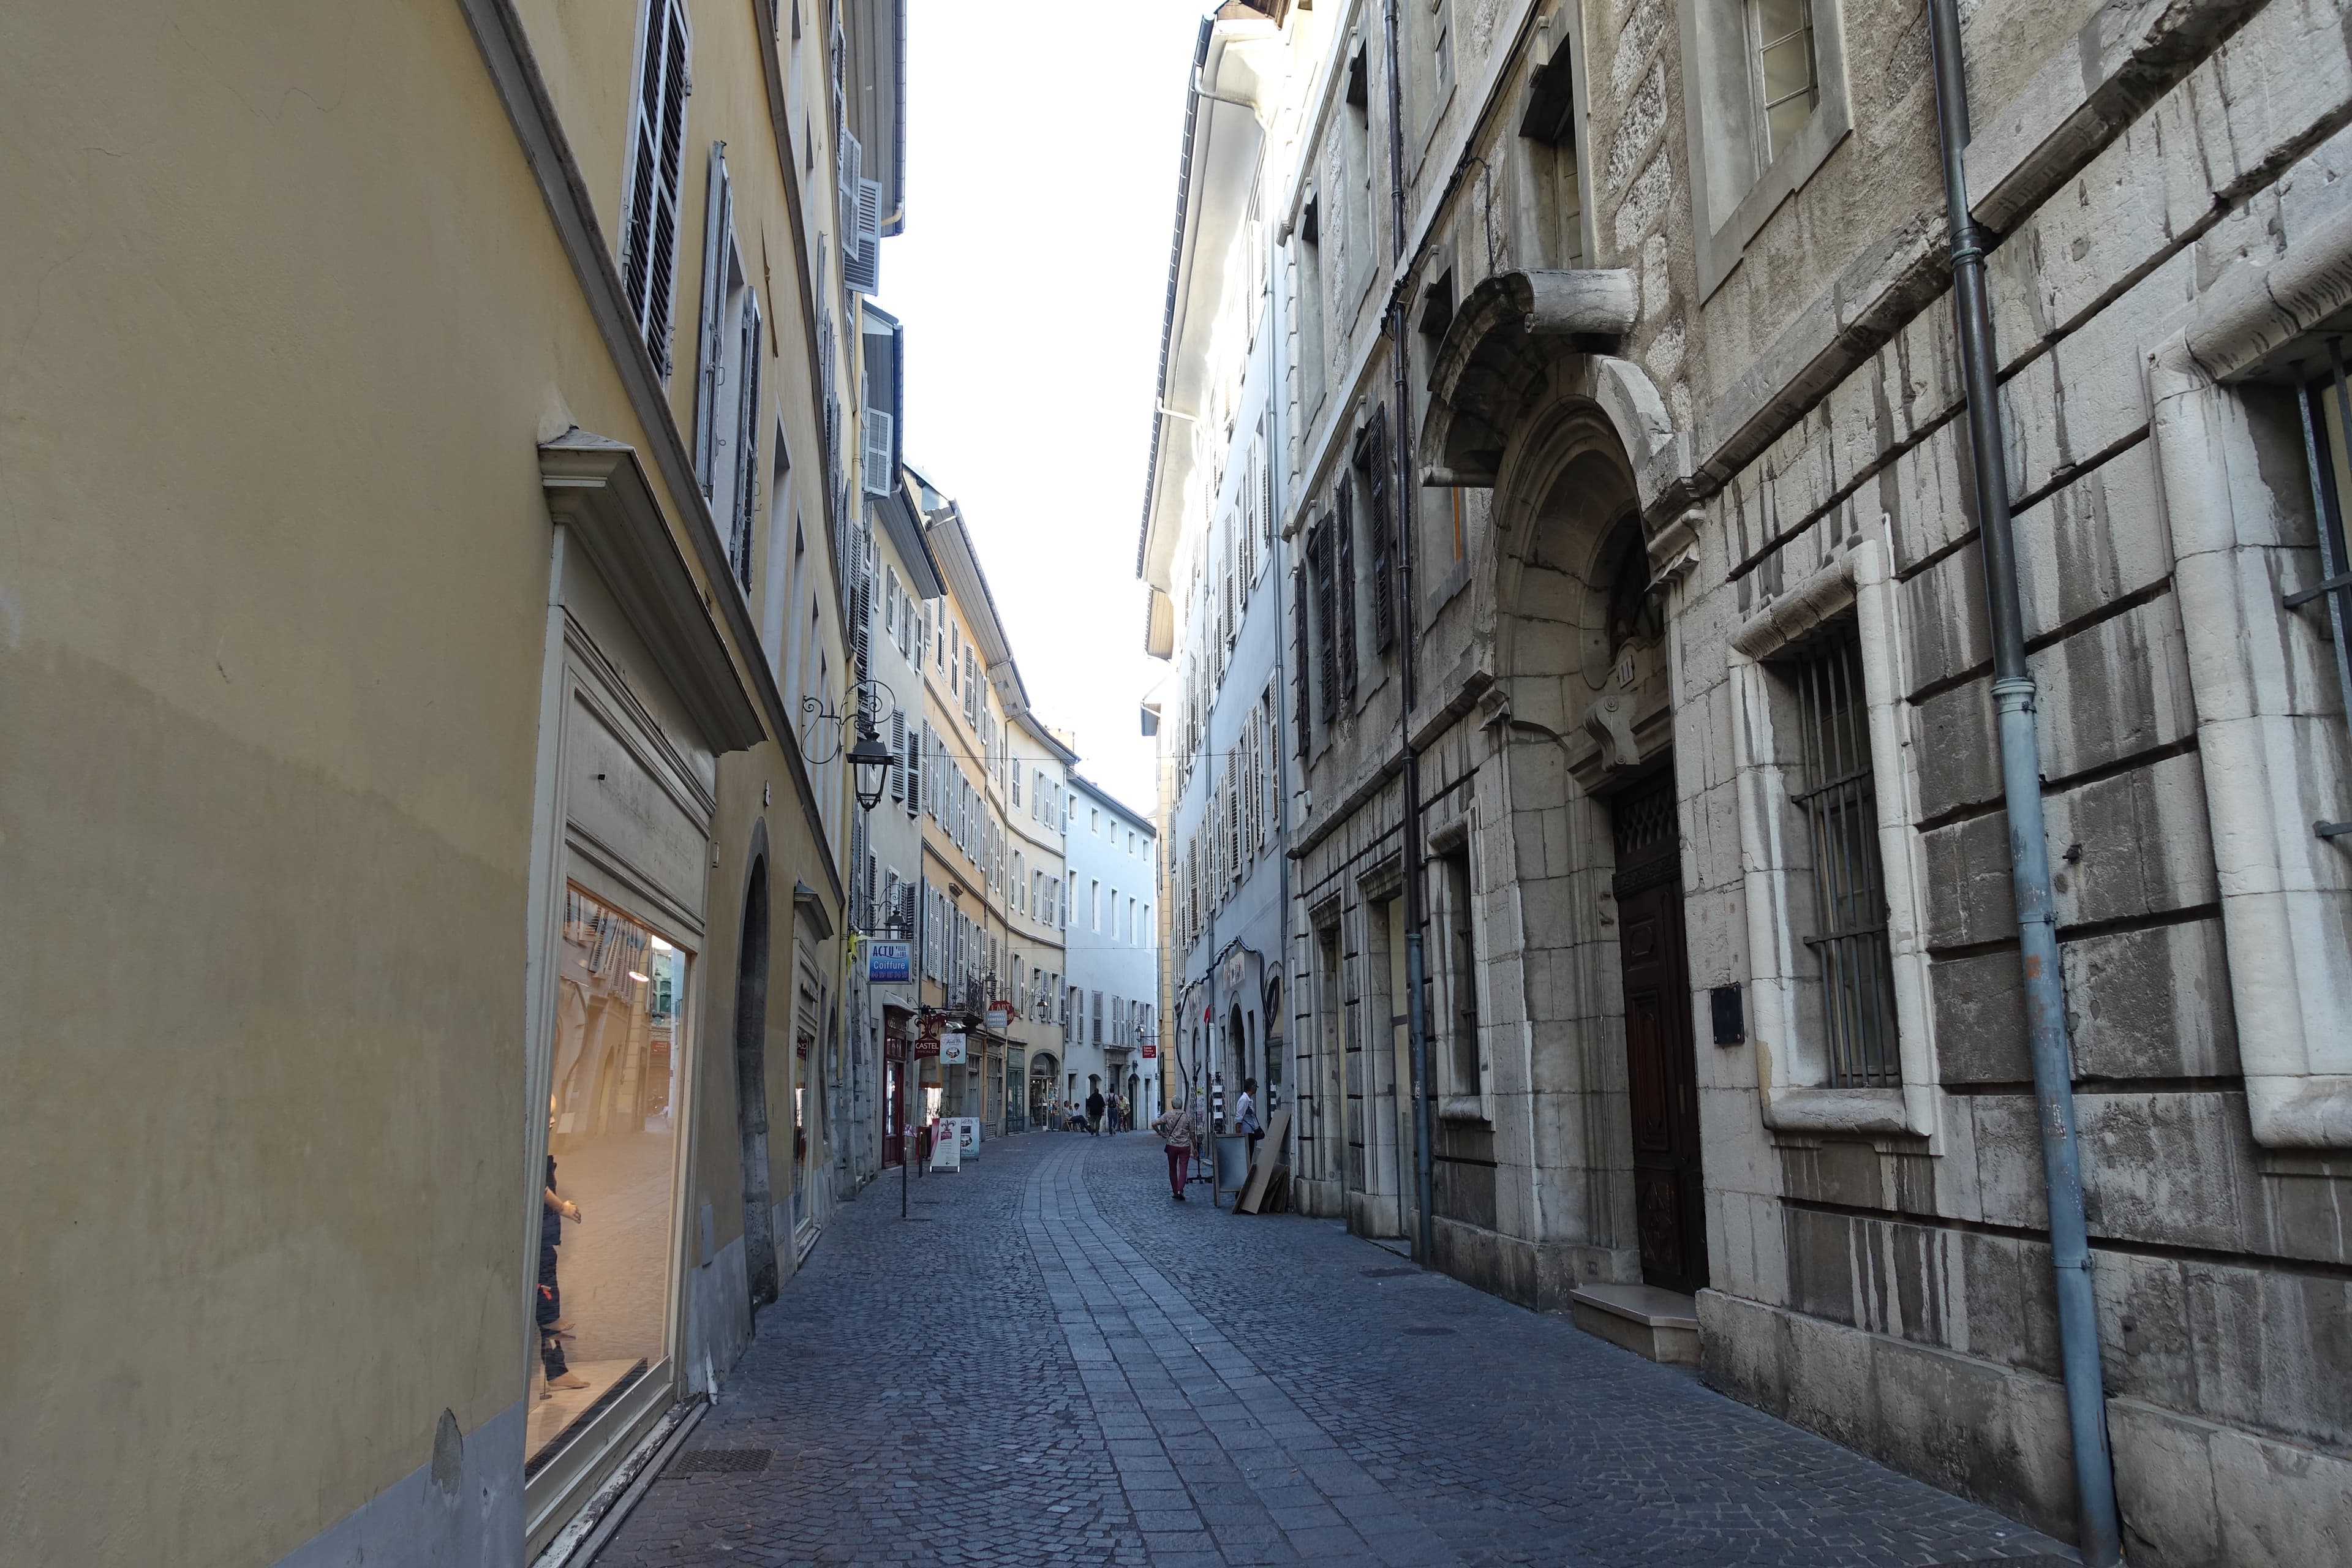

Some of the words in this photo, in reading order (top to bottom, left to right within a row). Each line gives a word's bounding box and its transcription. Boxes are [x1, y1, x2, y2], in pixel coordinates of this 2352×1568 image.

[1621, 661, 1630, 681] 11
[873, 946, 894, 956] ACTU
[873, 960, 905, 970] Coiffure
